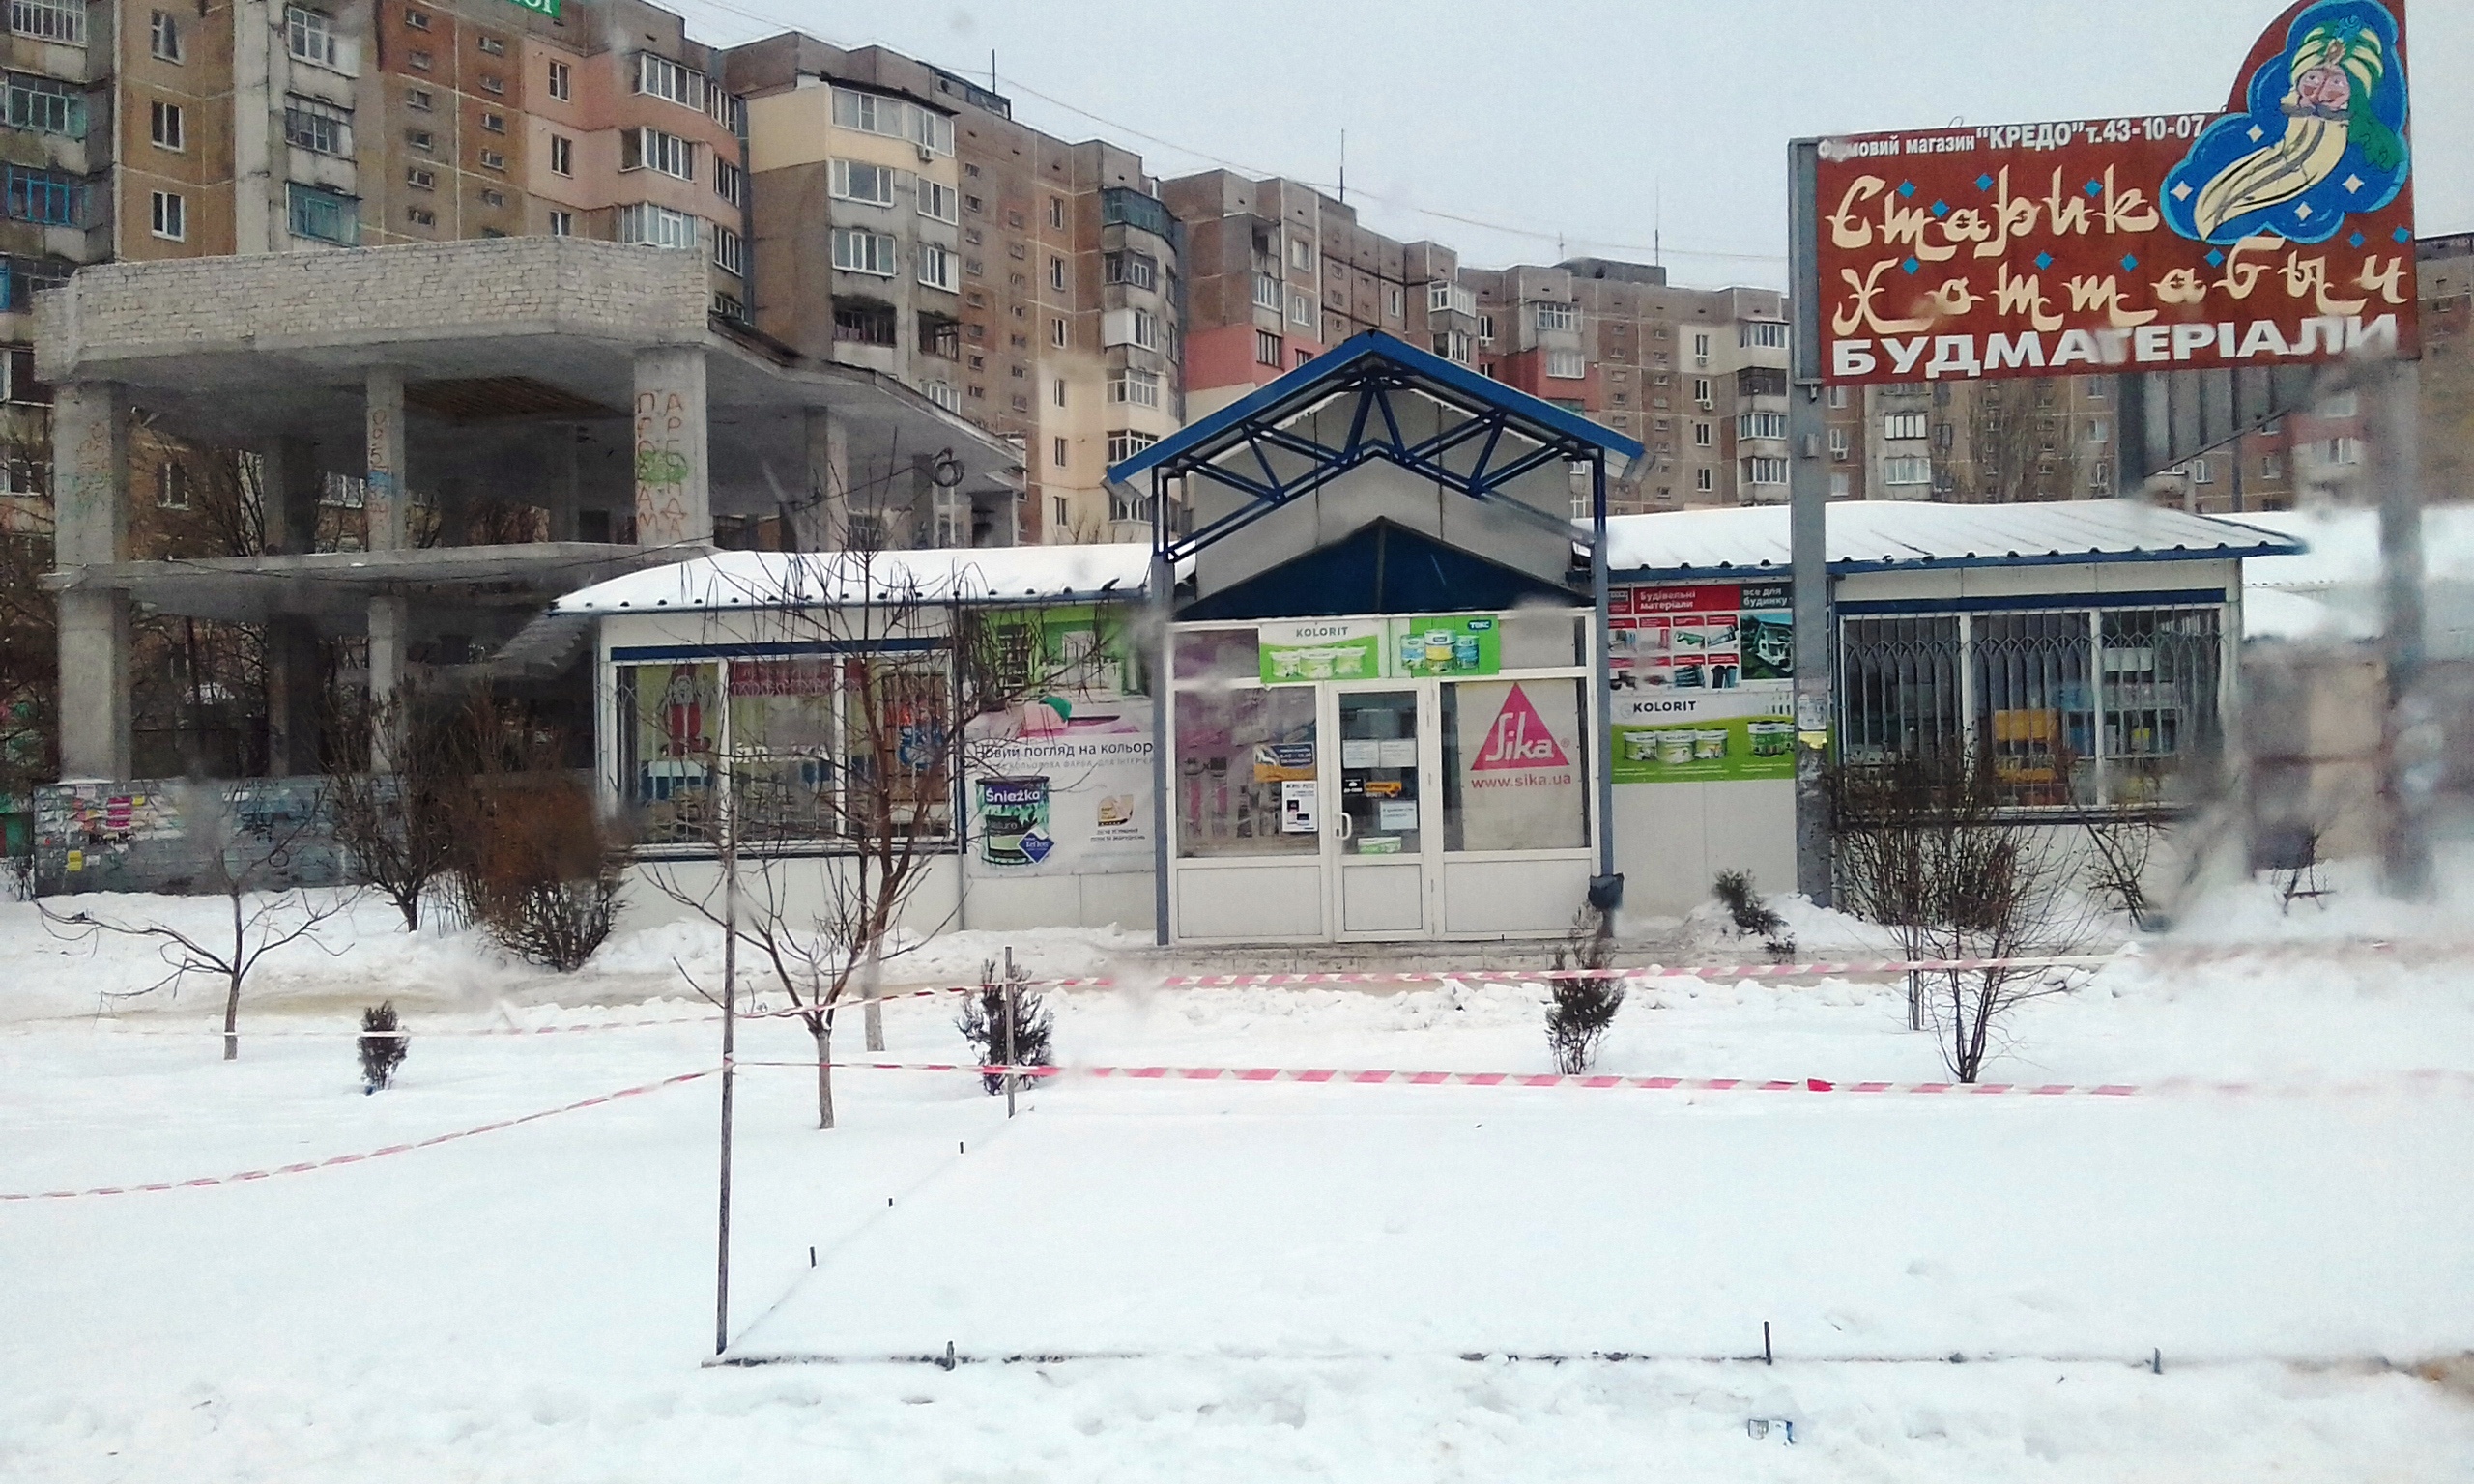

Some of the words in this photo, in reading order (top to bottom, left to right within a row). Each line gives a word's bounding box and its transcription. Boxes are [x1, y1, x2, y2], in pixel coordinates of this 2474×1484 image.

[1818, 134, 1899, 159] Фмовий
[1906, 135, 1975, 155] магазин
[1826, 163, 2160, 261] Старик
[1832, 236, 2409, 336] Хоттабыч
[1832, 313, 2399, 380] БУДМАТЕРІАЛИ
[1762, 587, 1782, 597] для
[1640, 600, 1694, 612] матеріали
[1743, 596, 1788, 607] будинку
[1295, 626, 1349, 638] KOLORIT
[1632, 700, 1697, 713] KOLORIT
[1484, 711, 1554, 762] Sika
[975, 743, 1021, 759] Новий
[1024, 743, 1075, 758] погляд
[1079, 744, 1096, 756] на
[1471, 772, 1572, 789] www.sika.ua
